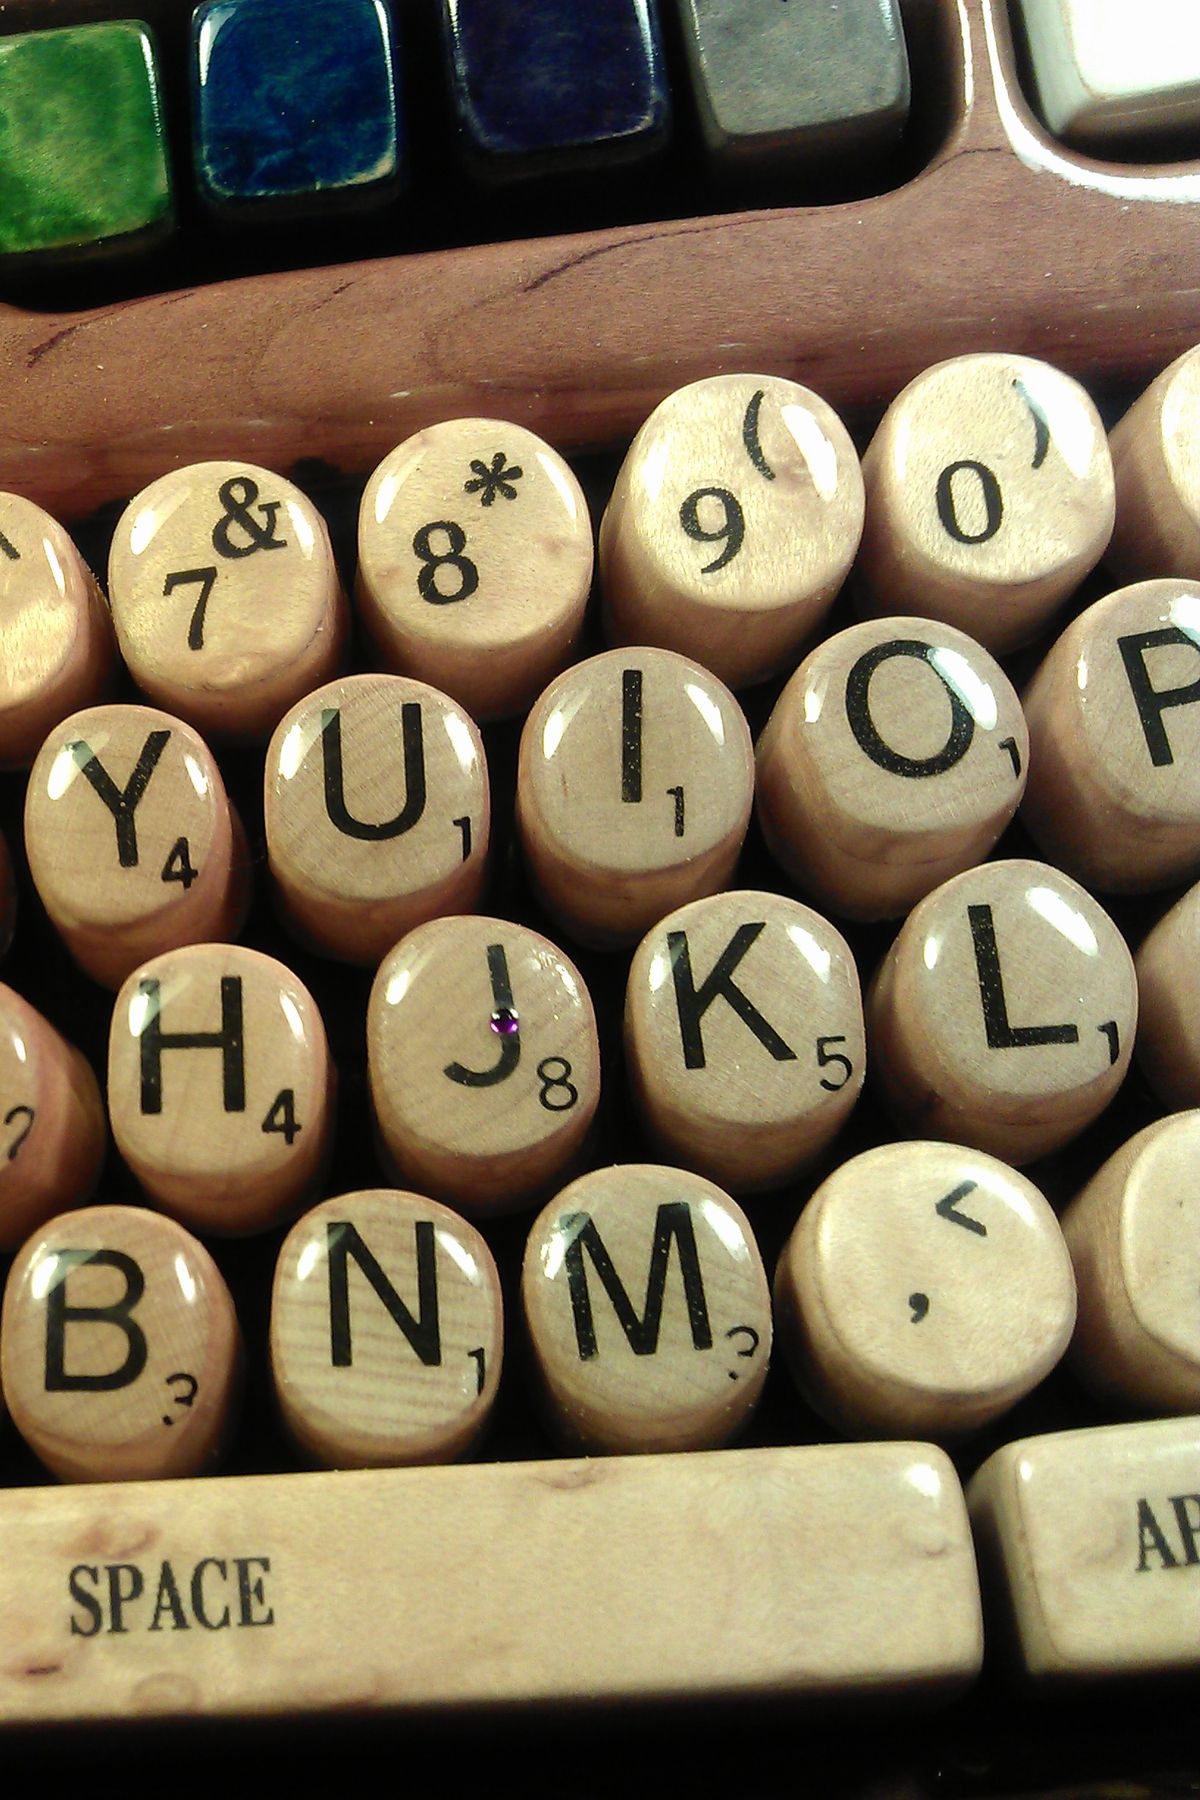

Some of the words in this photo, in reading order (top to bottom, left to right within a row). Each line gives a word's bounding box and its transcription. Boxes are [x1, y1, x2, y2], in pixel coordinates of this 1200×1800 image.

[162, 567, 218, 651] 7
[211, 476, 287, 560] &
[412, 520, 480, 605] 8
[679, 486, 745, 573] 9
[936, 460, 1004, 544] 0
[621, 669, 642, 802] I
[666, 786, 684, 836] 1
[845, 639, 975, 778] O
[1117, 626, 1200, 767] P
[65, 730, 172, 868] Y
[161, 837, 199, 889] 4
[321, 702, 426, 841] U
[452, 816, 472, 862] 1
[140, 976, 246, 1115] H
[261, 1089, 302, 1145] 4
[443, 943, 522, 1088] J
[536, 1056, 579, 1112] 8
[667, 921, 798, 1070] K
[815, 1035, 852, 1092] 5
[967, 904, 1079, 1049] L
[1097, 1019, 1120, 1065] 1
[44, 1247, 149, 1393] B
[326, 1221, 441, 1367] N
[467, 1347, 486, 1396] 1
[560, 1202, 713, 1362] M
[68, 1557, 274, 1637] SPACE
